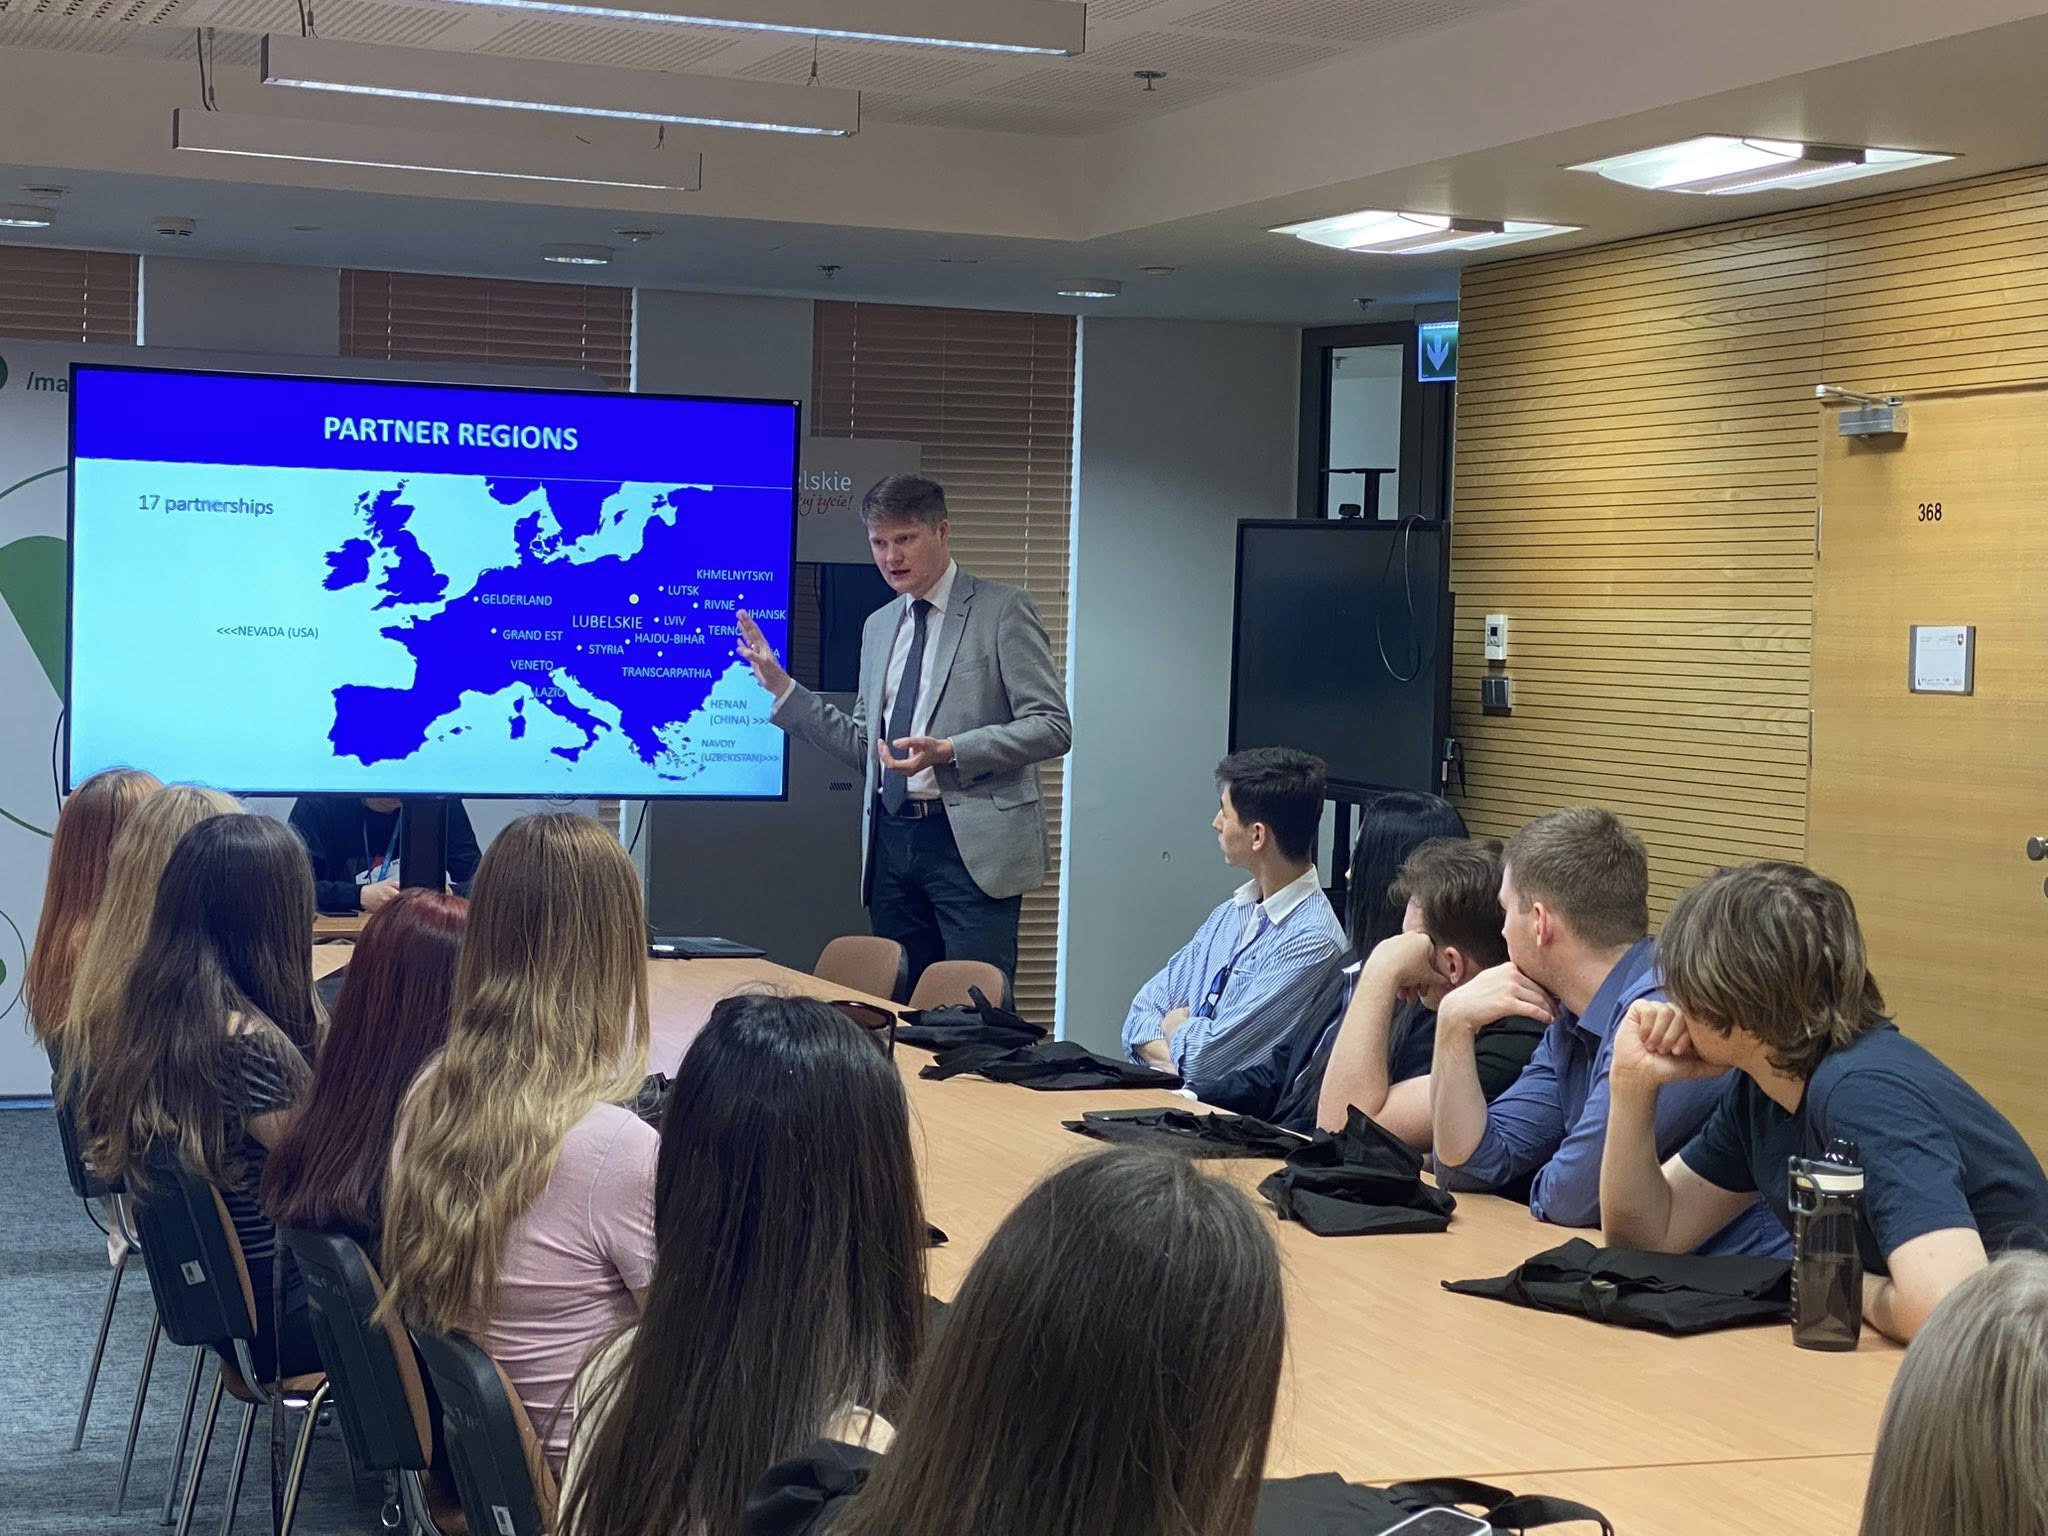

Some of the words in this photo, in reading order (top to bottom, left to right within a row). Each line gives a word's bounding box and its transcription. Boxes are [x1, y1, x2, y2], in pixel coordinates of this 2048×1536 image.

[323, 416, 450, 445] PARTNER
[457, 422, 579, 451] REGIONS
[799, 470, 851, 491] lskie
[138, 494, 161, 511] 17
[165, 497, 274, 518] partnerships
[1917, 502, 1942, 521] 368
[696, 569, 773, 581] KHMELNYTSKYI
[667, 585, 700, 596] LUTSK
[481, 594, 553, 606] GELDERLAND
[704, 600, 736, 611] RIVNE
[572, 615, 643, 629] LUBELSKIE
[663, 615, 686, 626] LVIV
[288, 627, 319, 640] (USA)
[502, 629, 542, 641] GRAND
[544, 630, 564, 641] EST
[634, 633, 705, 644] HAJDU-BIHAR
[588, 644, 625, 655] STYRIA
[510, 660, 554, 670] VENETO
[621, 667, 712, 678] TRANSCARPATHIA
[535, 687, 566, 698] LAZIO
[710, 699, 748, 710] HENAN
[709, 714, 750, 727] (CHINA)
[701, 739, 736, 748] NAVOIY
